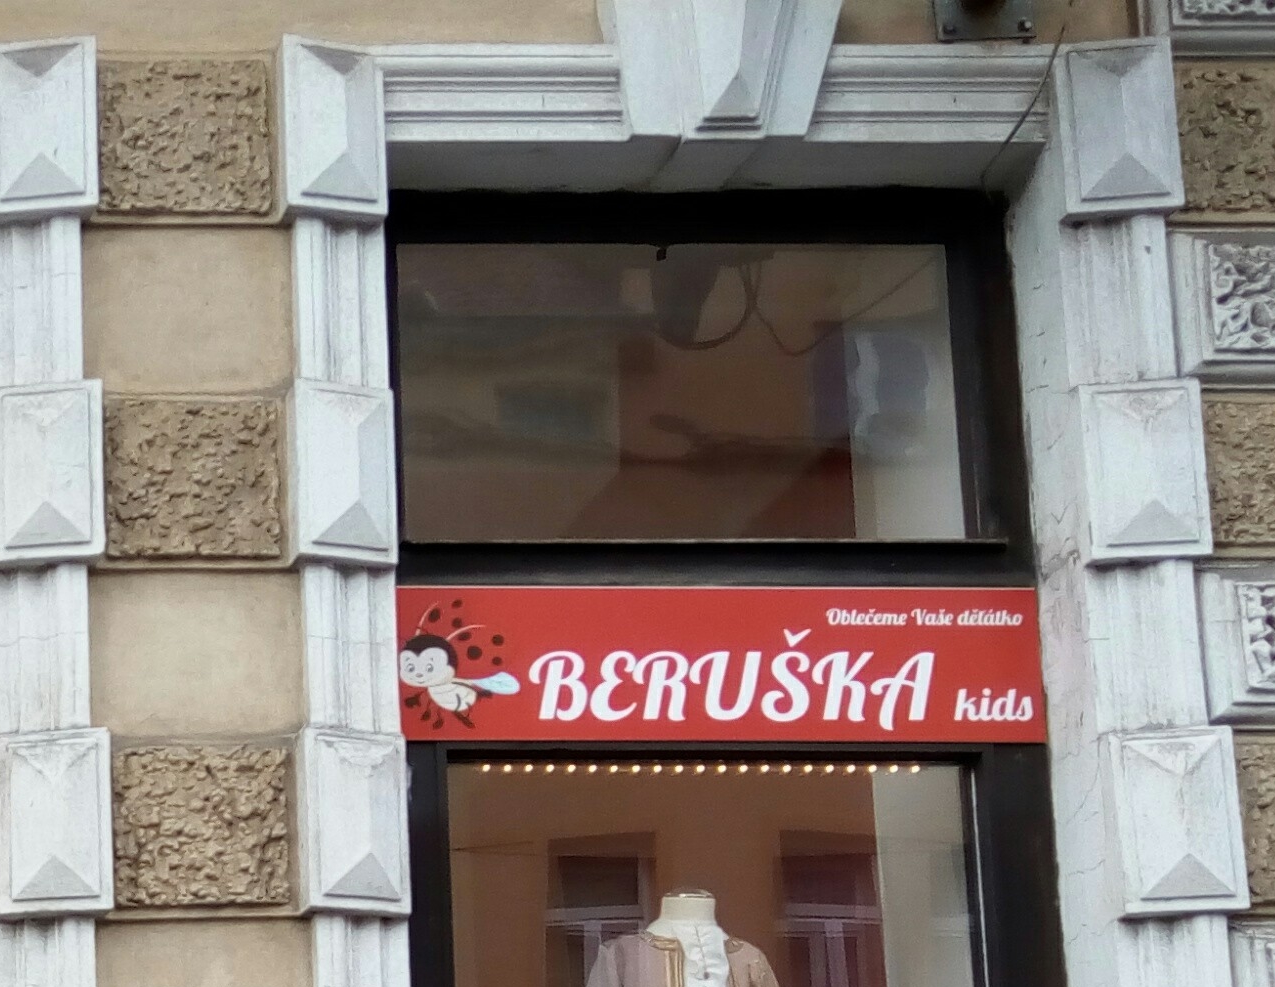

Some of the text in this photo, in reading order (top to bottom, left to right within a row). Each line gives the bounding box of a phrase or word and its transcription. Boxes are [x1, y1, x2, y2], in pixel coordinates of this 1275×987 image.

[825, 607, 908, 626] Oblečeme
[910, 608, 954, 626] Vaše
[528, 628, 1034, 731] BERUŠKA kids
